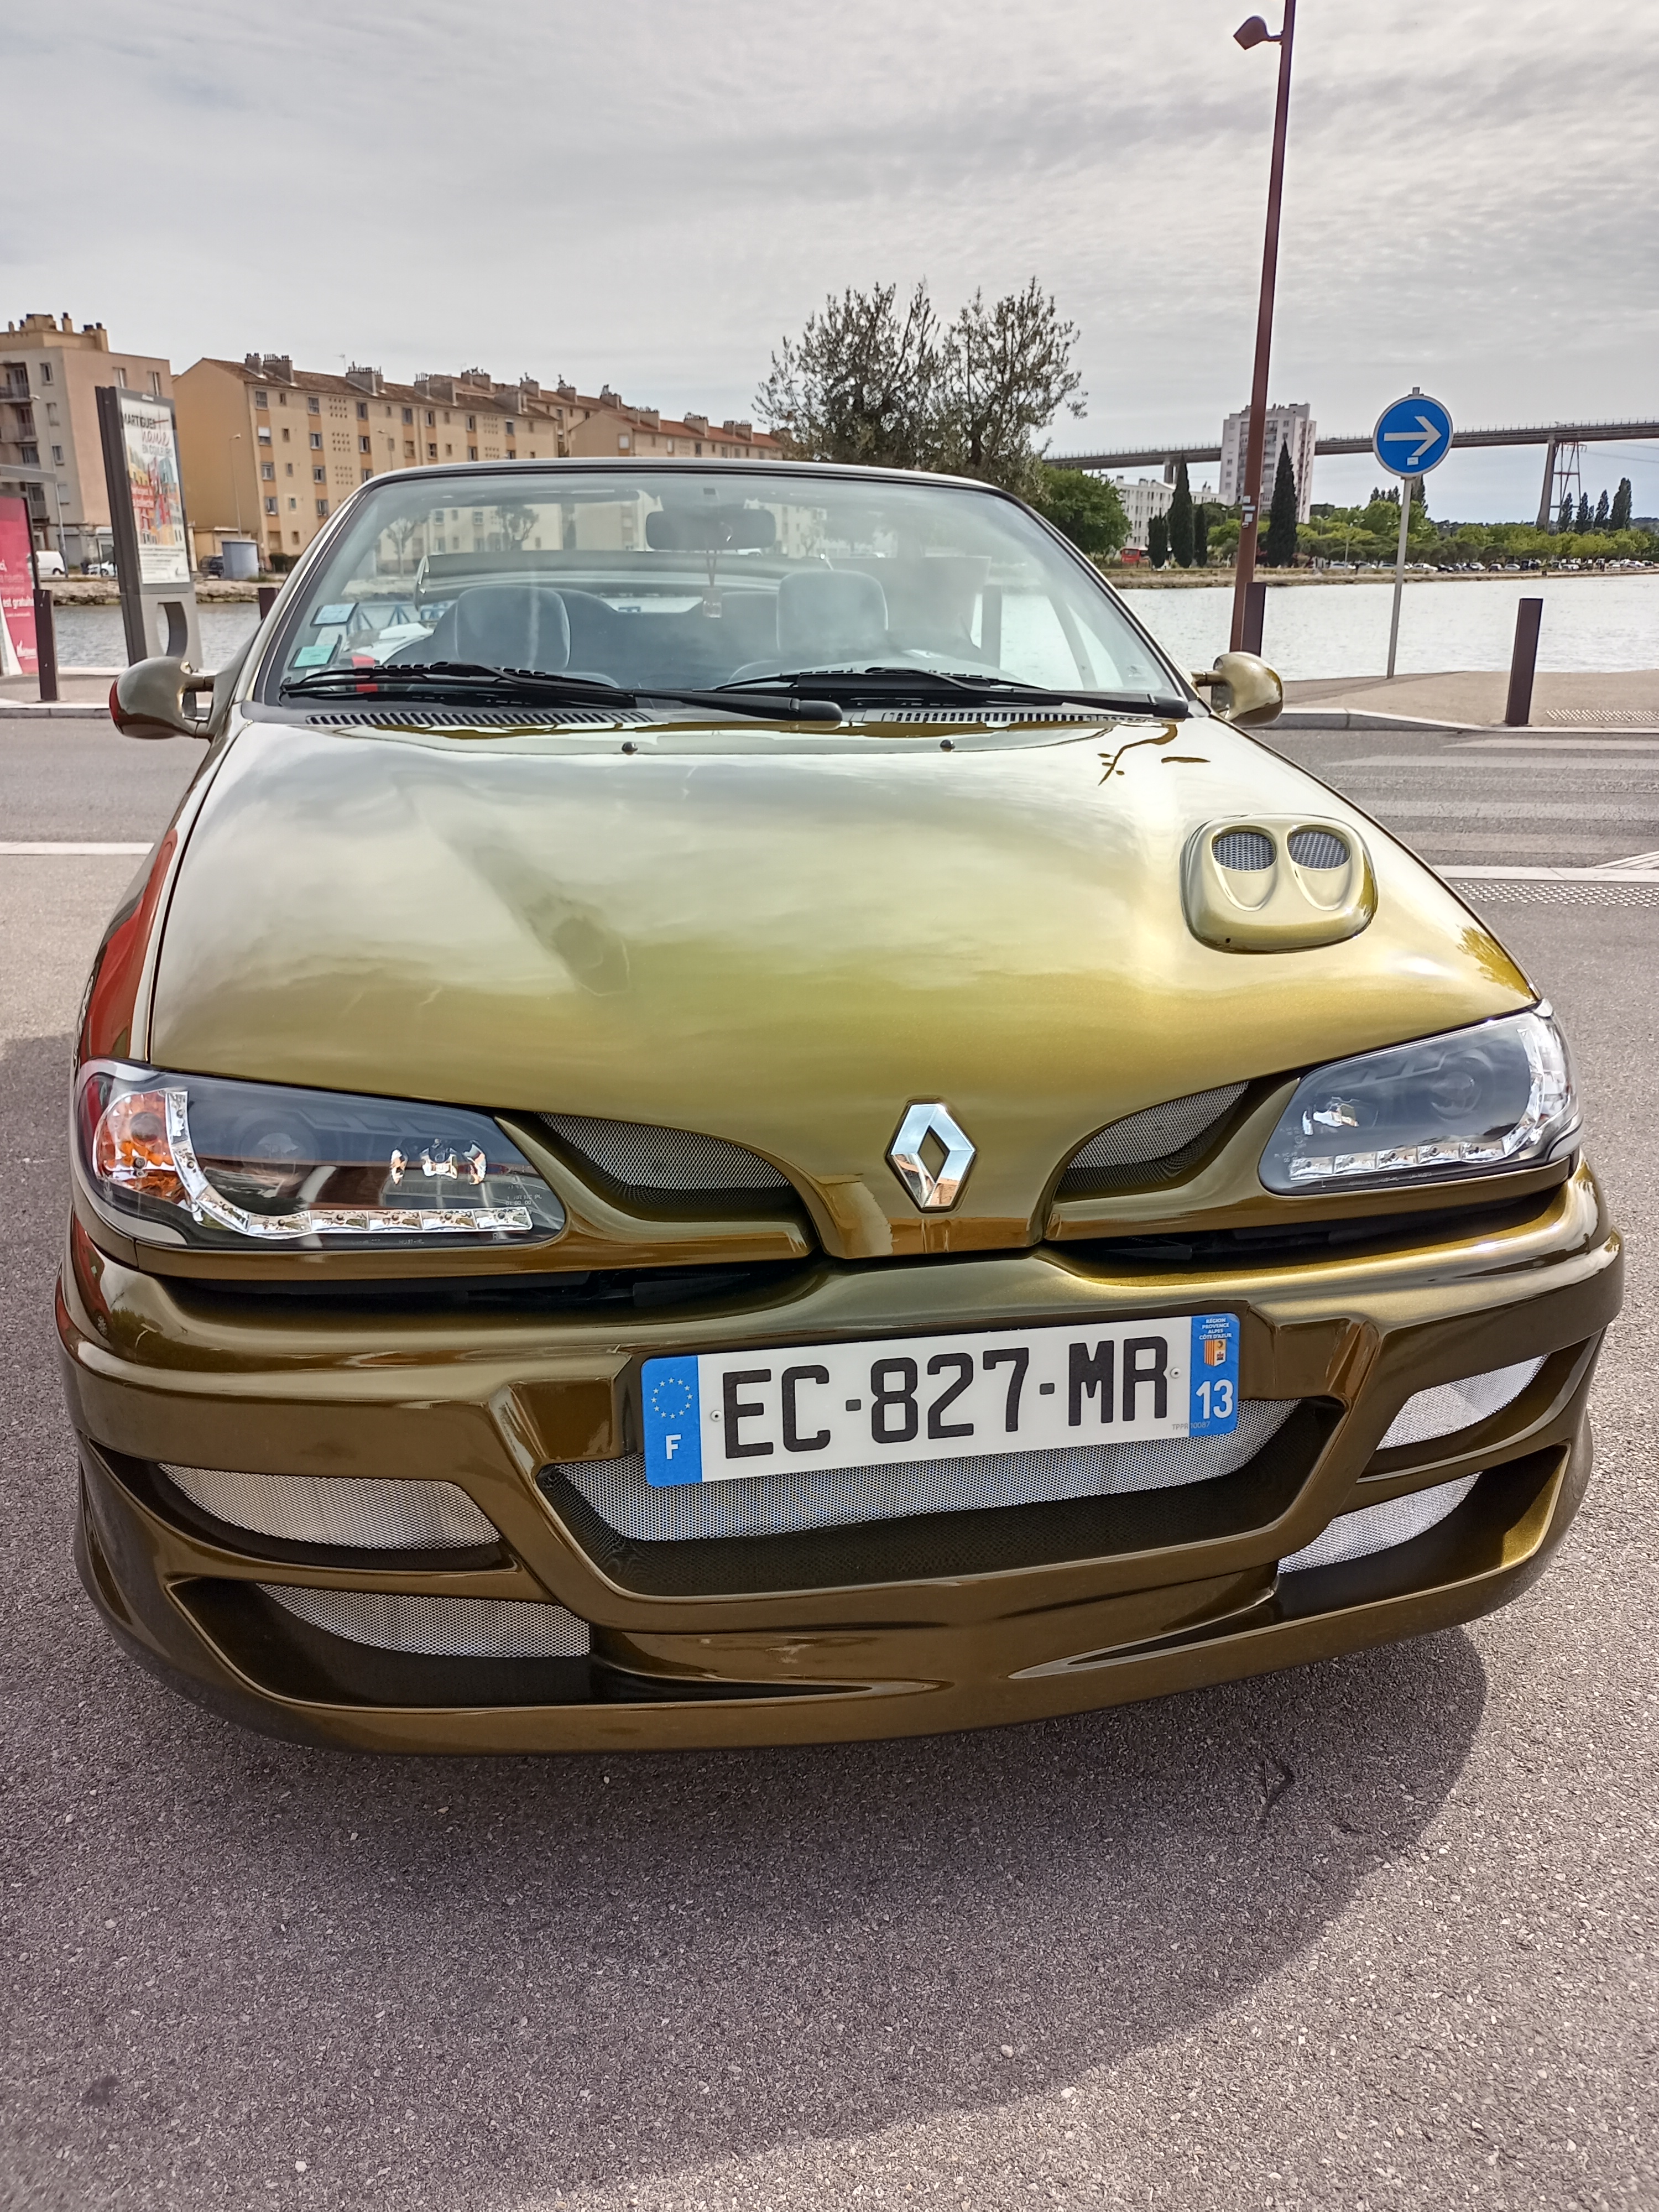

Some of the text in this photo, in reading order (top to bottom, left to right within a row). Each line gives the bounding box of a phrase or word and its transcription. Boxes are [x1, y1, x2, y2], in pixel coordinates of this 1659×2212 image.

[722, 1335, 1168, 1459] EC-827-MR
[1196, 1379, 1233, 1420] 13
[665, 1434, 681, 1460] F
